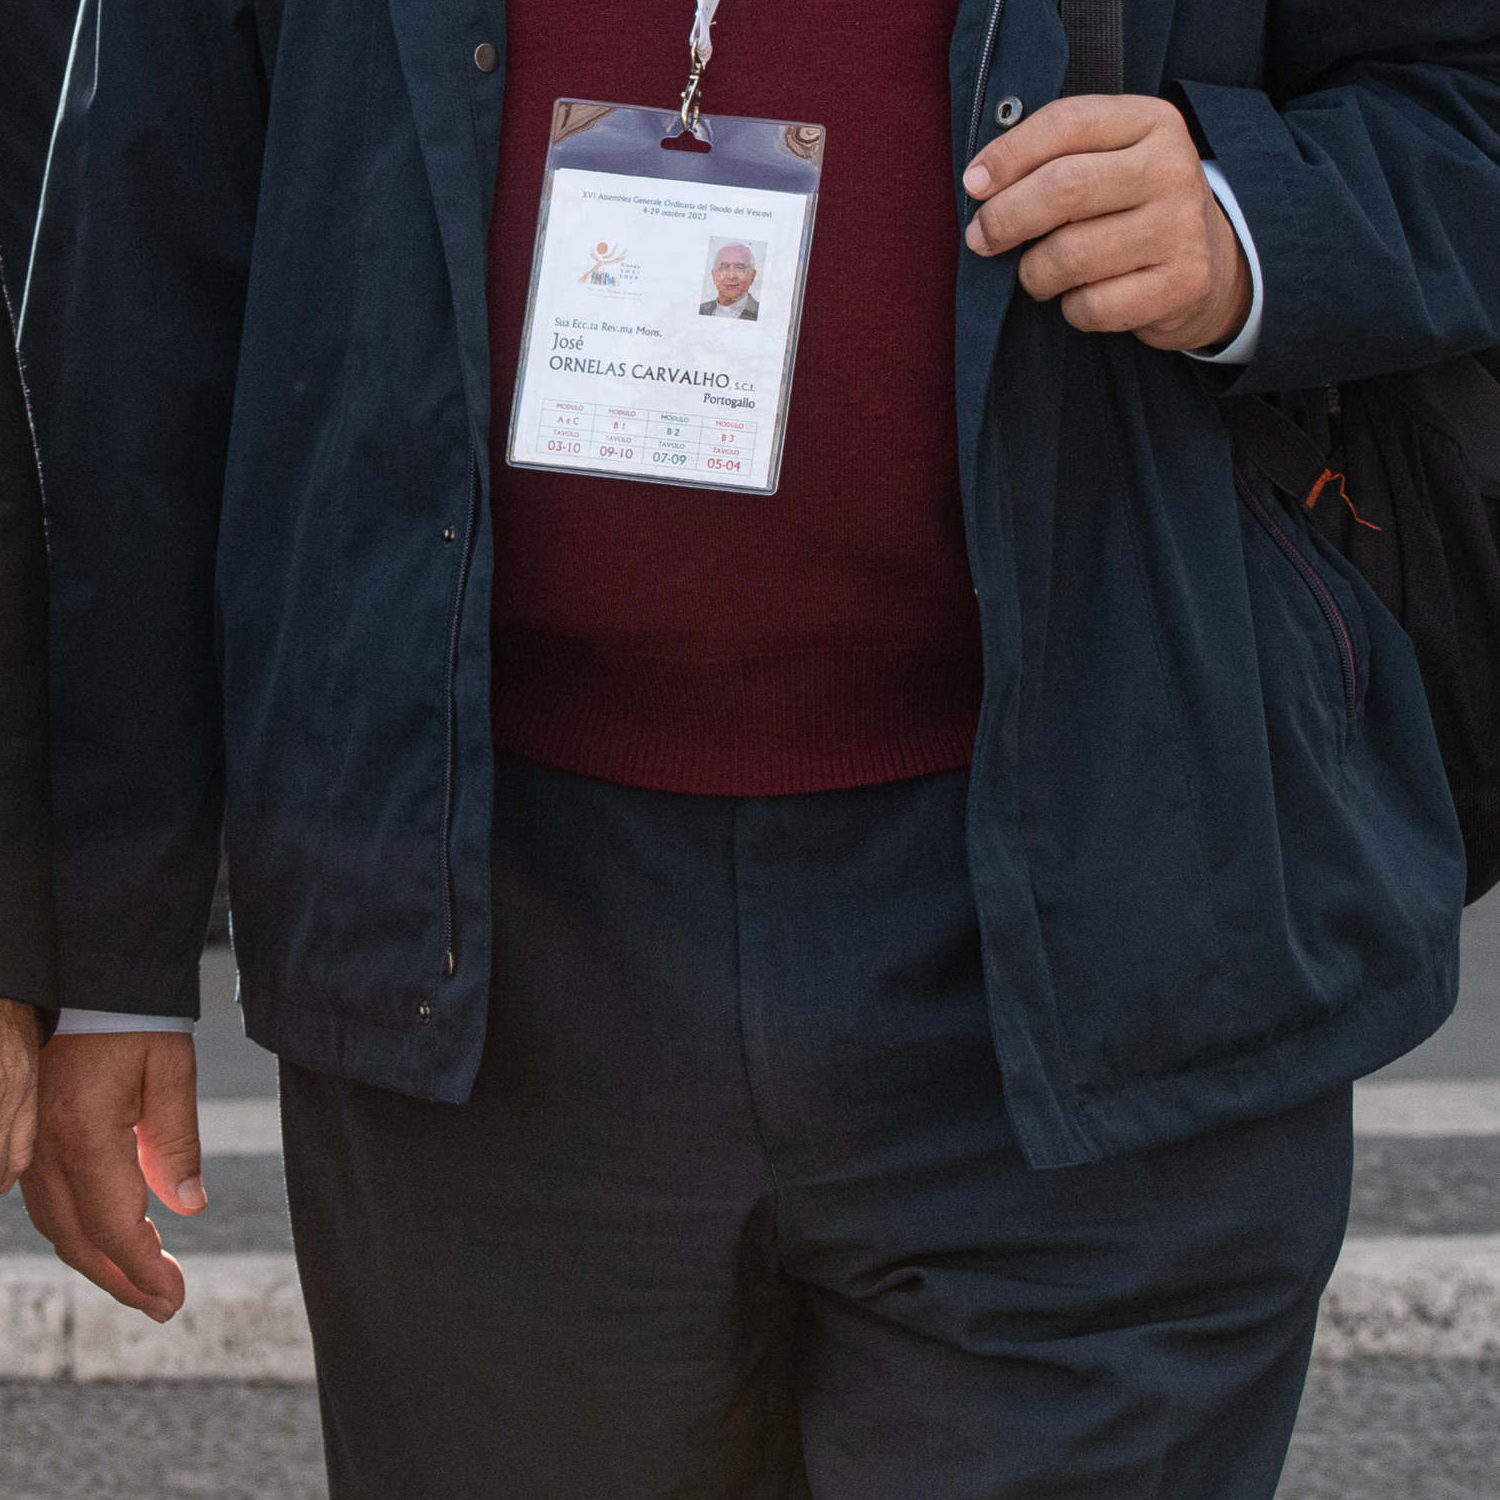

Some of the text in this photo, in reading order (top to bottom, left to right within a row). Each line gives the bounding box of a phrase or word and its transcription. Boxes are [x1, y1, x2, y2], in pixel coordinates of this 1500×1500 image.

[582, 191, 596, 199] XVI
[598, 193, 631, 202] Assemblea
[633, 196, 662, 206] Generale
[664, 199, 695, 209] Ordinaria
[697, 203, 708, 211] del
[709, 204, 732, 213] Sinodo
[747, 208, 772, 218] Vescovi
[643, 207, 659, 215] 4-29
[688, 212, 706, 220] 2023
[555, 317, 662, 337] Sua Ecc.za Rev.ma Mons.
[551, 332, 584, 350] José
[549, 356, 626, 377] ORNELAS
[703, 393, 755, 409] Portogallo
[556, 403, 584, 411] MODULO
[608, 408, 636, 417] MODULO
[573, 417, 579, 425] C
[661, 414, 689, 423] MODULO
[716, 421, 744, 429] MODULO
[553, 429, 579, 437] TAVOLO
[667, 427, 680, 436] B 2
[605, 435, 631, 443] TAVOLO
[548, 440, 581, 453] 03-10
[659, 441, 685, 449] TAVOLO
[600, 446, 633, 459] 09-10
[713, 447, 739, 456] TAVOLO
[653, 452, 686, 465] 07-09
[707, 458, 740, 471] 05-04
